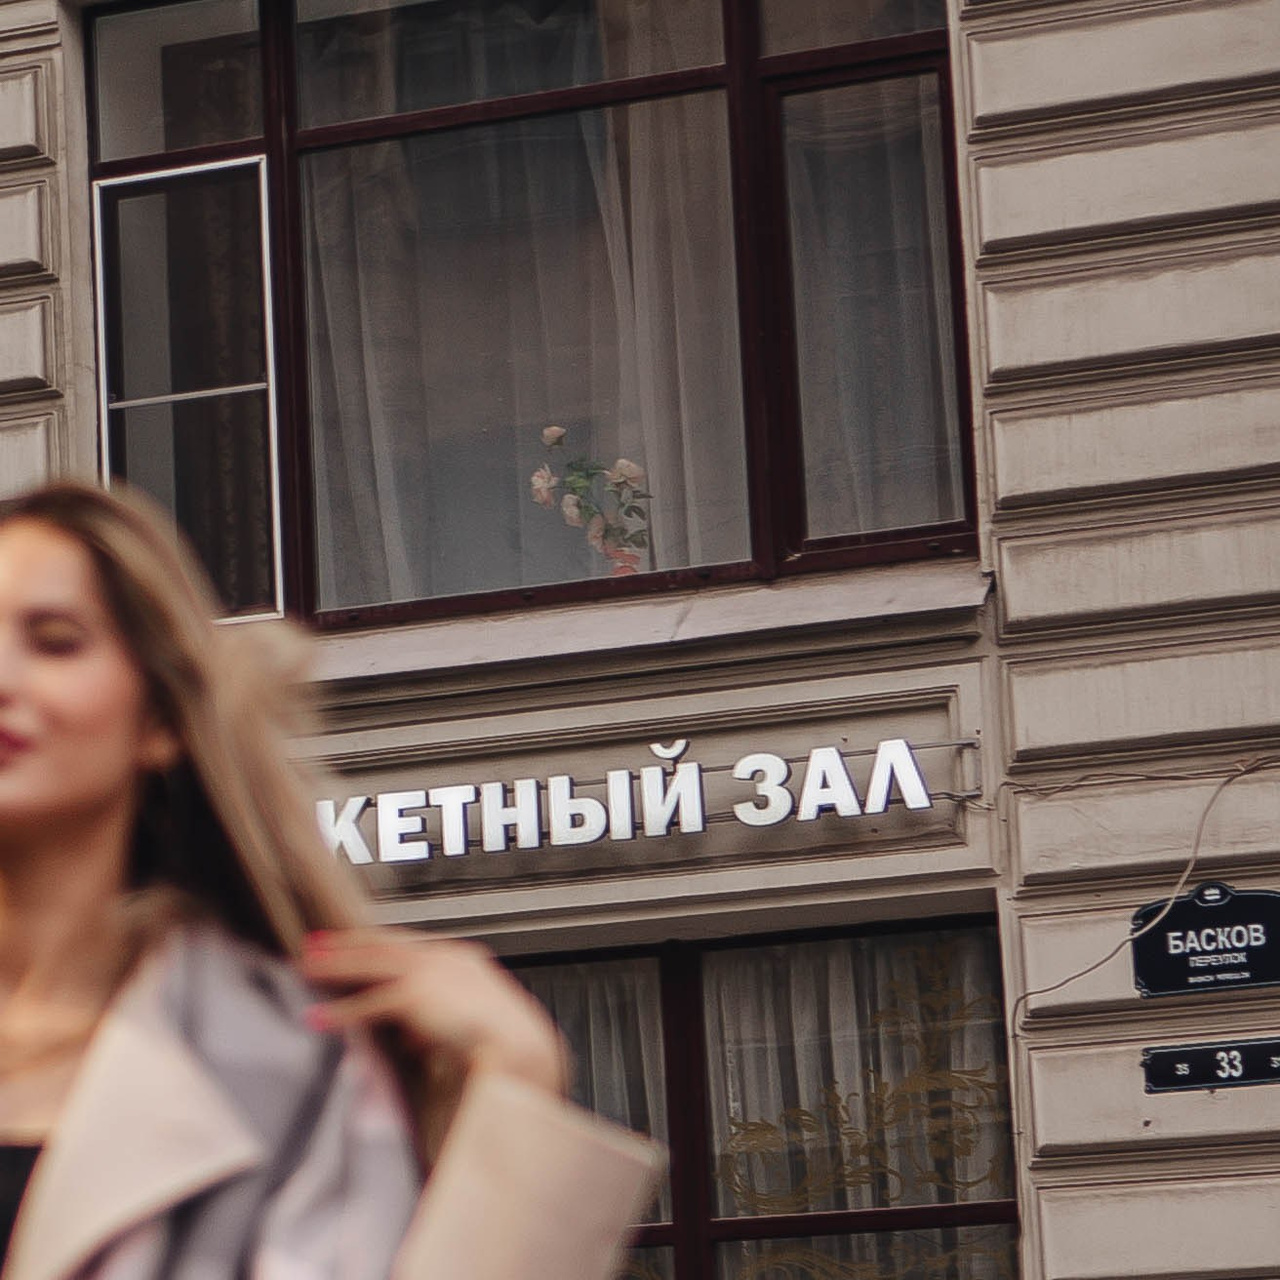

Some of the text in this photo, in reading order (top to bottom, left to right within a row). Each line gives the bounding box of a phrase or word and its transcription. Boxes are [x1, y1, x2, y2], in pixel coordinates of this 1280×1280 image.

[316, 738, 932, 865] КЕТНЫЙ ЗАЛ
[1167, 924, 1267, 954] БАСКОВ
[1216, 1050, 1243, 1078] 33
